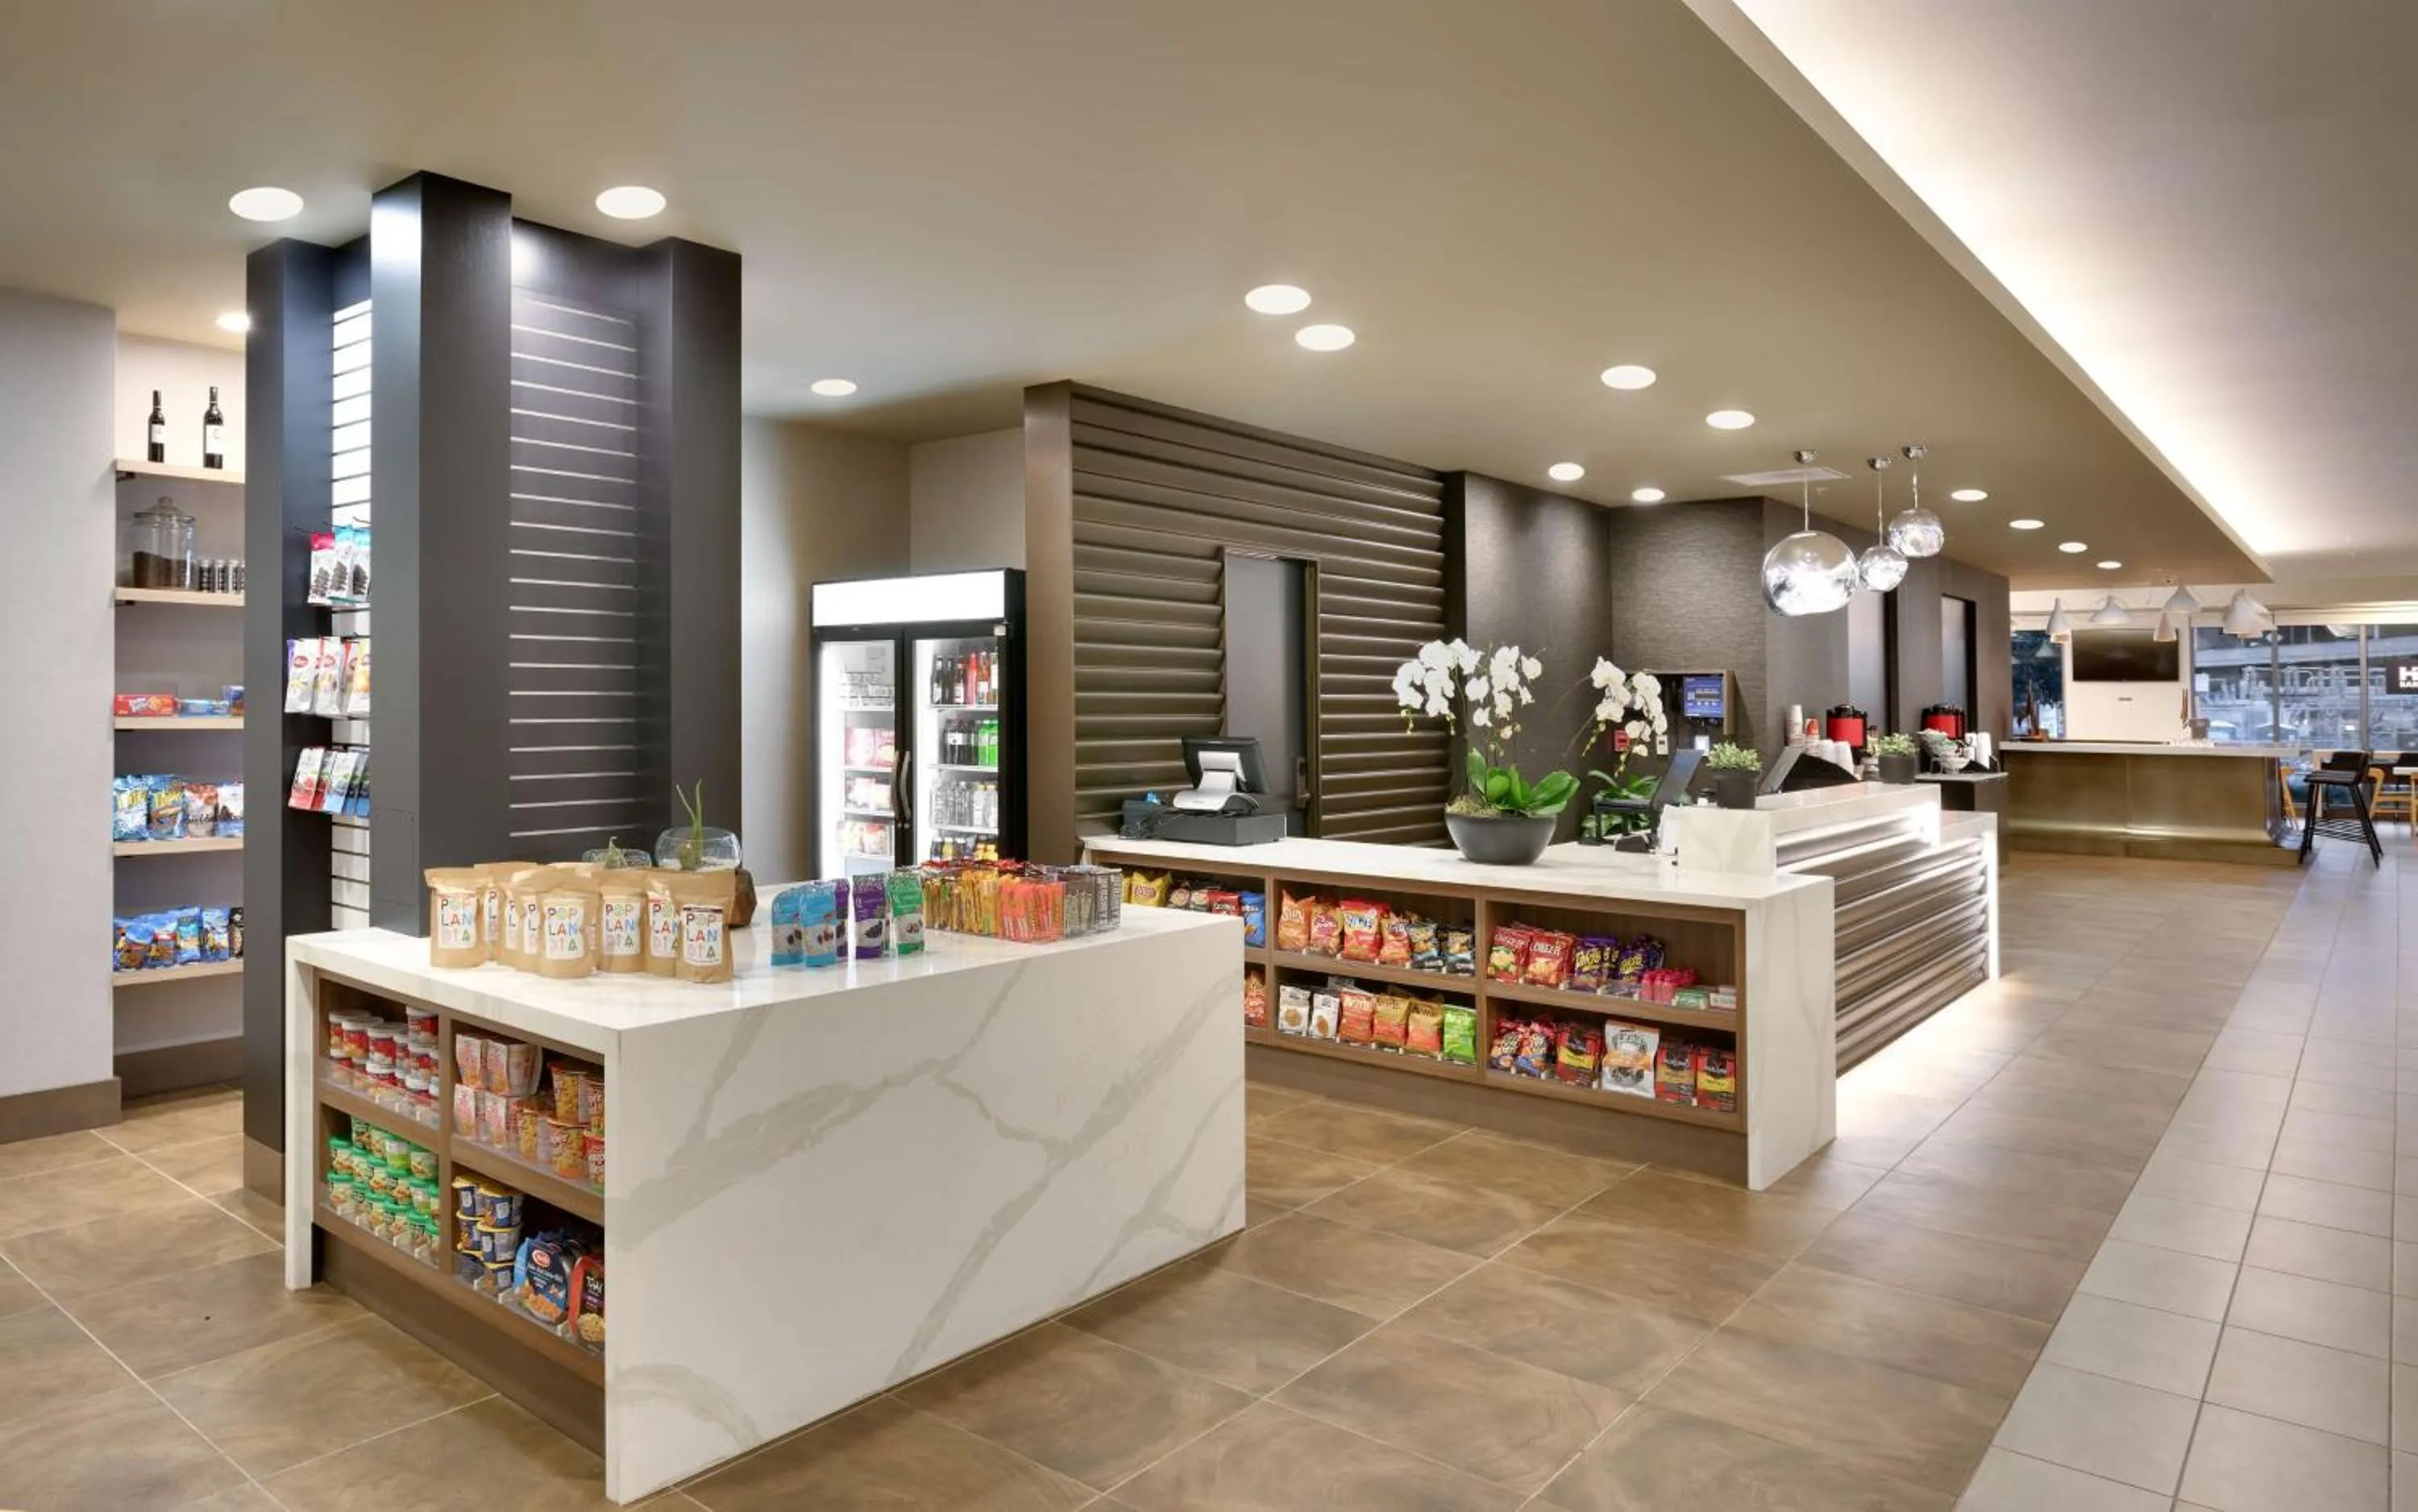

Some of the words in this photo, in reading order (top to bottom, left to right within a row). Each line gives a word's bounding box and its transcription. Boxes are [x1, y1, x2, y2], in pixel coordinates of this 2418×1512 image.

[547, 907, 578, 920] POP
[605, 903, 634, 917] POP
[441, 911, 472, 927] LAN
[605, 917, 636, 933] LAN
[685, 913, 717, 926] POP
[548, 921, 578, 936] LAN
[686, 928, 717, 942] LAN
